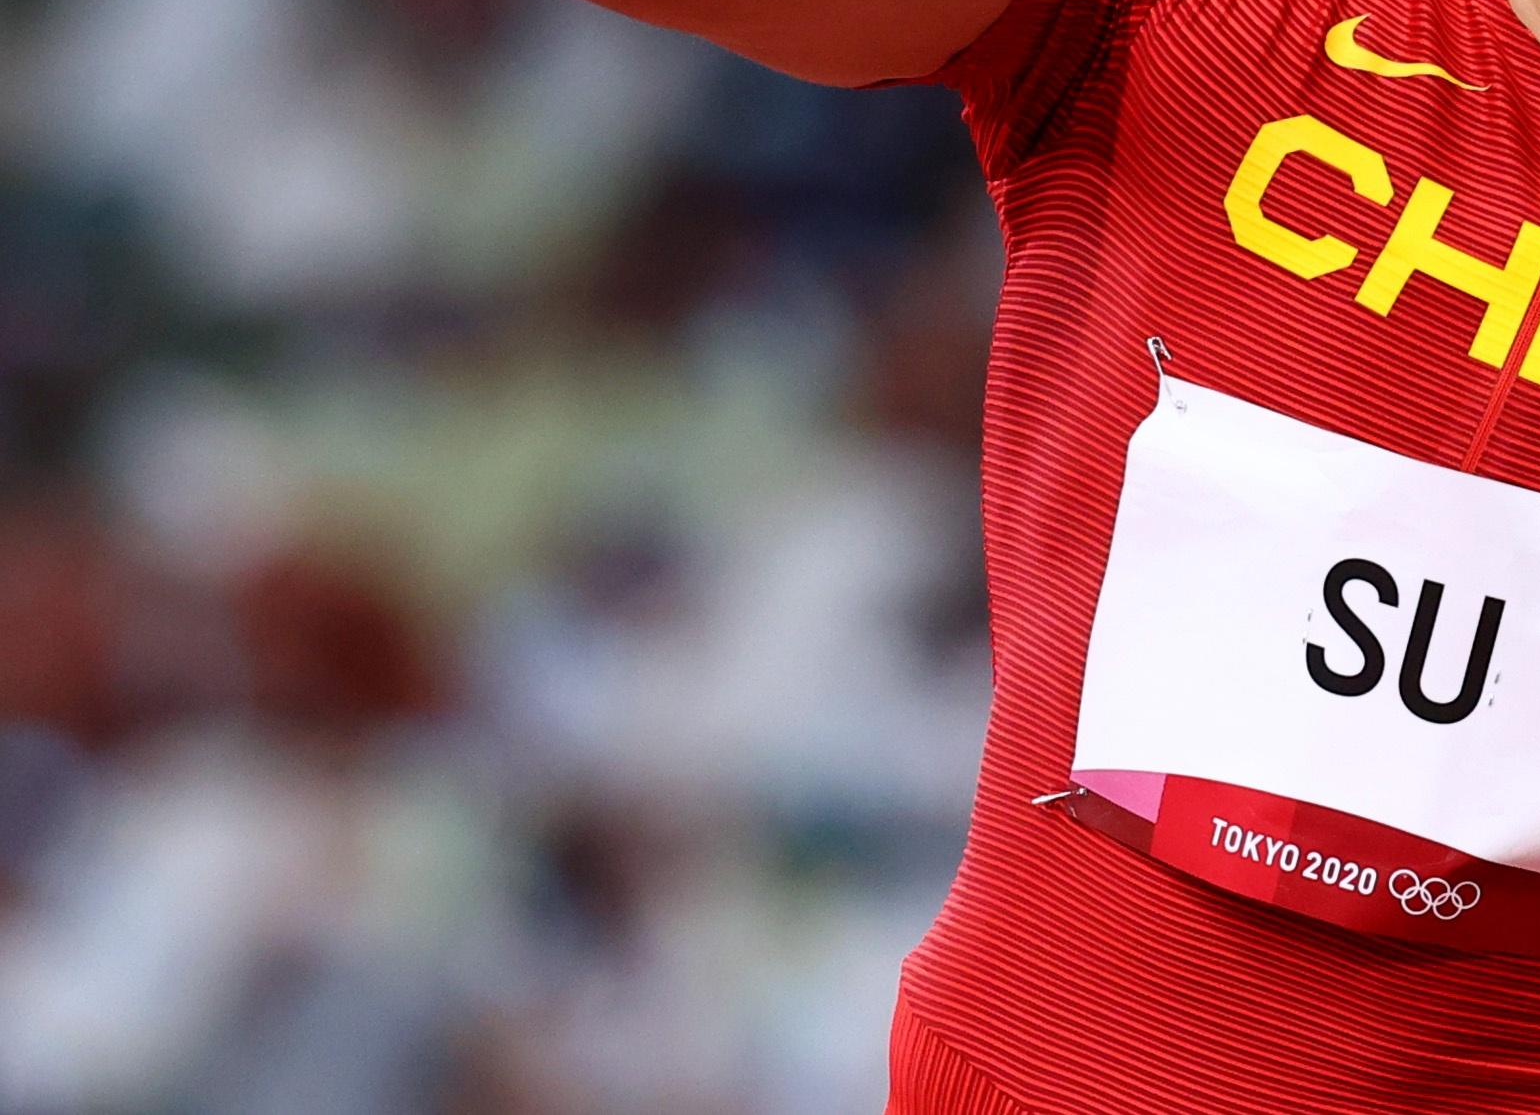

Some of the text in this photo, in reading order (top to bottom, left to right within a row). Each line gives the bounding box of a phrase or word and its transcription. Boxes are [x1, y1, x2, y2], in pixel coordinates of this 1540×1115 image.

[1306, 558, 1506, 724] SU
[1211, 818, 1377, 895] TOKYO 2020
